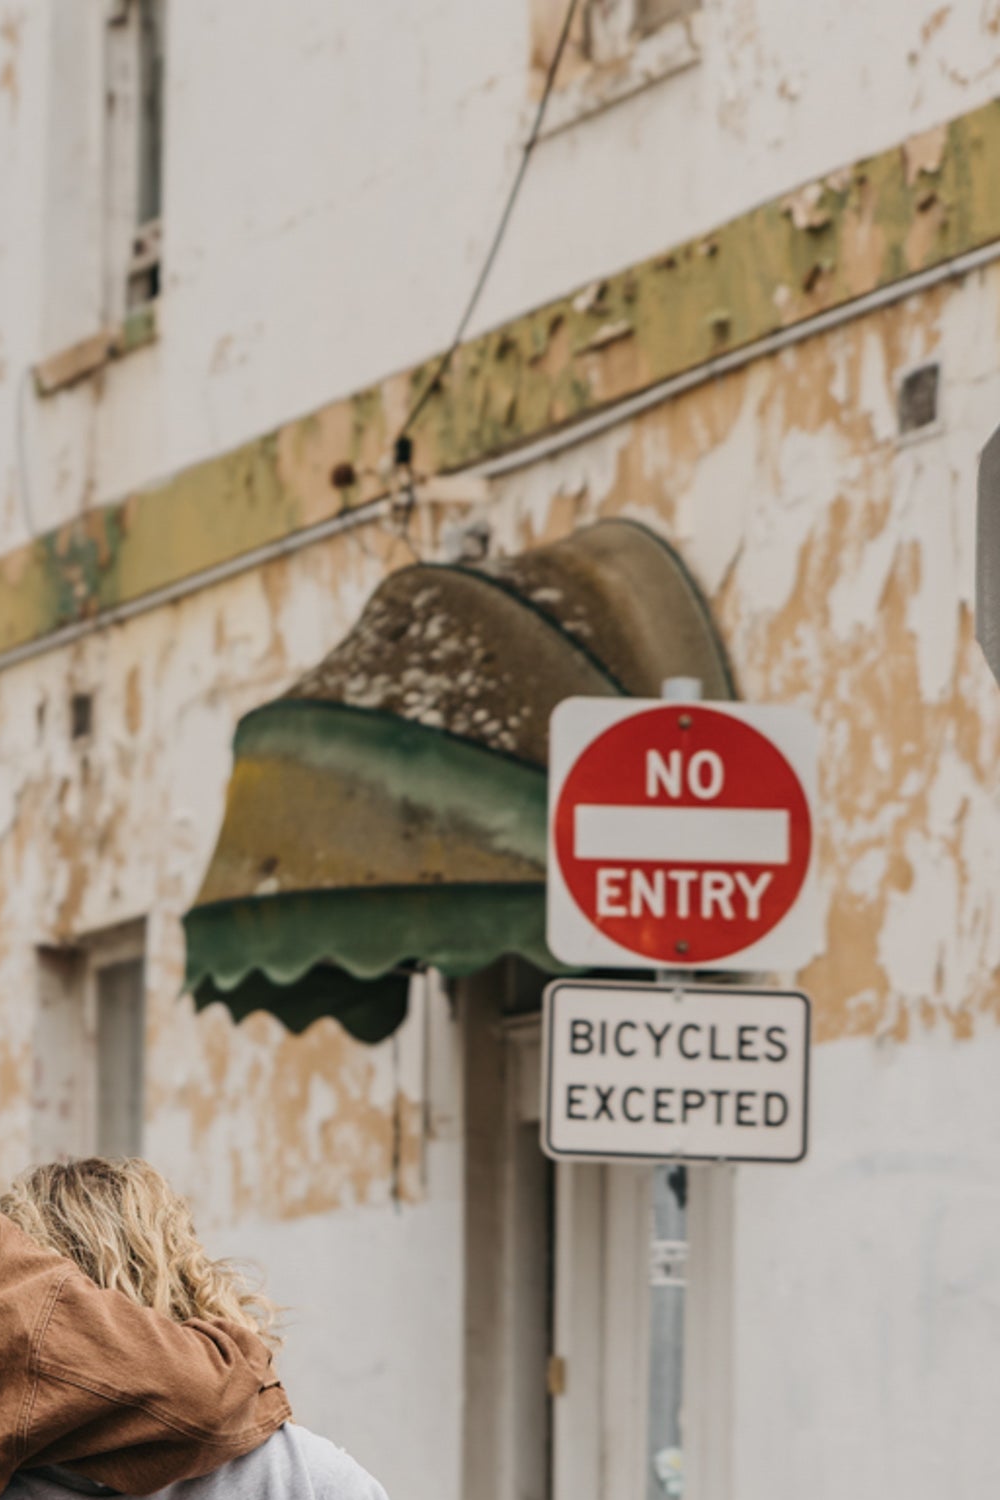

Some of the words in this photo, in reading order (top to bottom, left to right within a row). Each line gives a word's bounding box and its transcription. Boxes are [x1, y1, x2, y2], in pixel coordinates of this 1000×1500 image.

[646, 749, 724, 800] NO
[596, 868, 773, 920] ENTRY
[569, 1019, 788, 1062] BICYCLES
[566, 1084, 788, 1127] EXCEPTED
